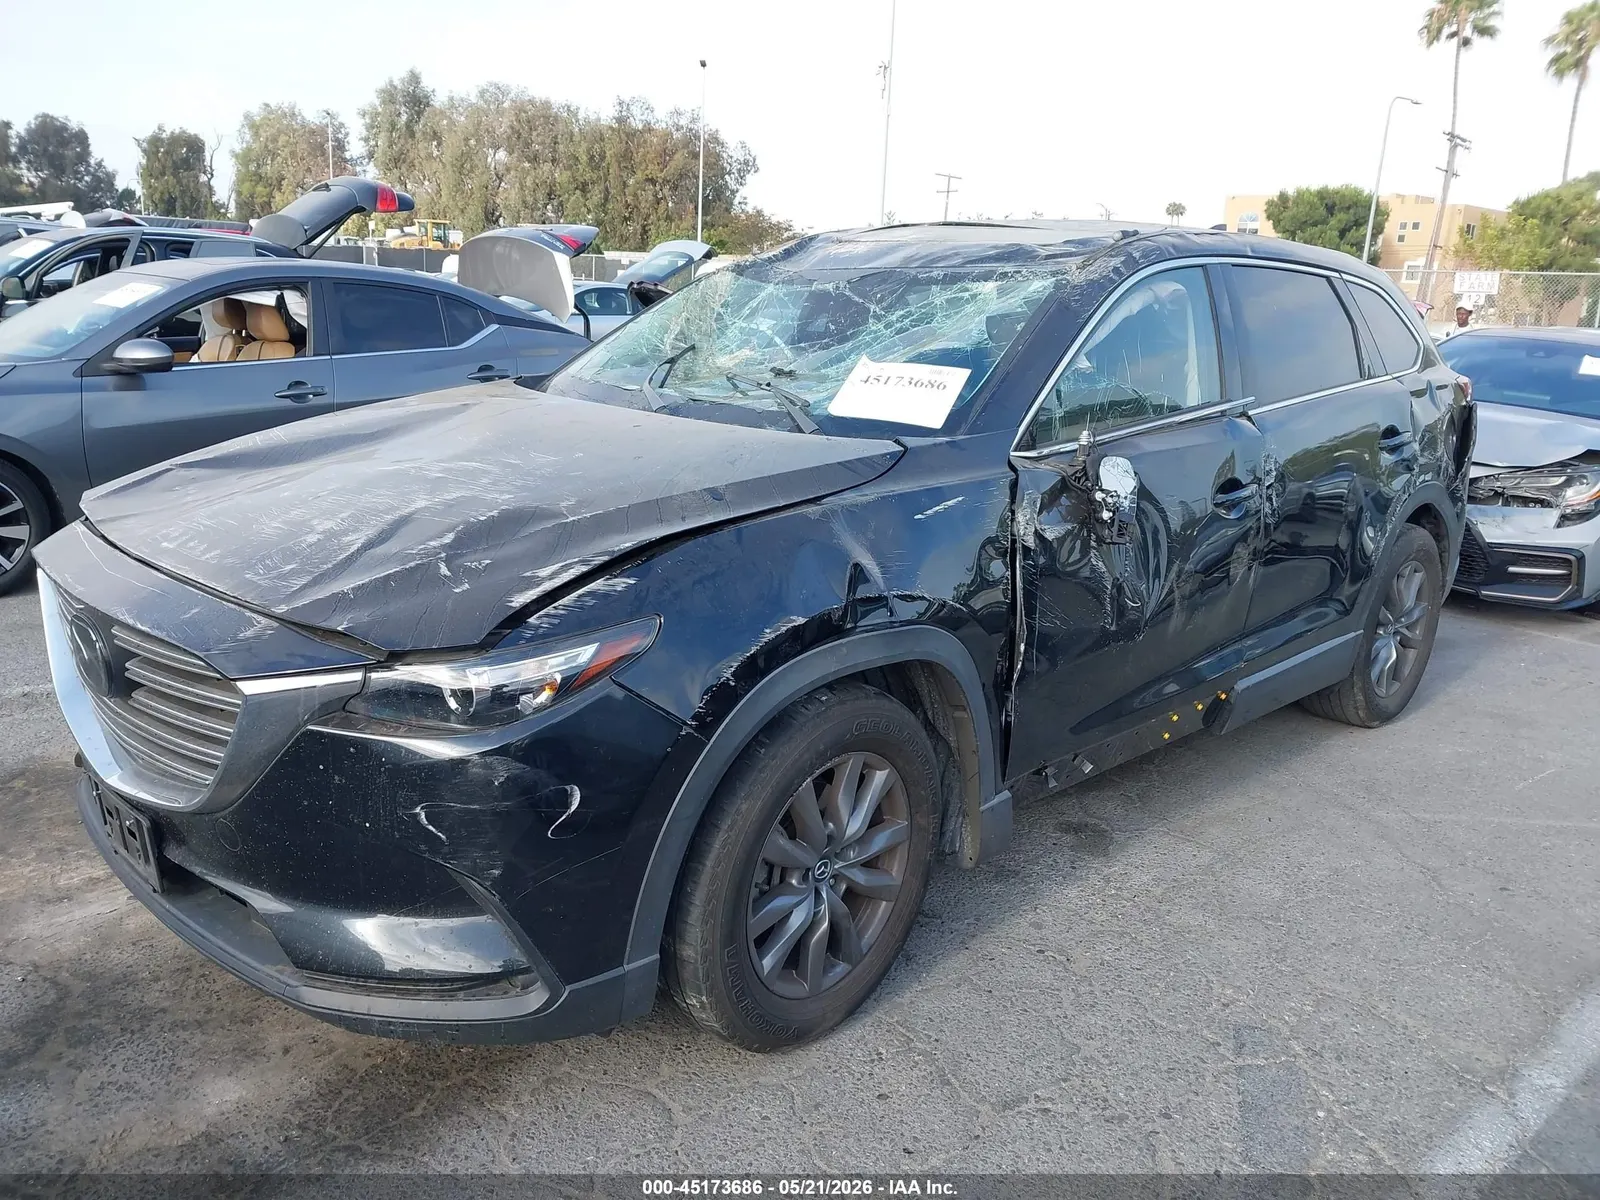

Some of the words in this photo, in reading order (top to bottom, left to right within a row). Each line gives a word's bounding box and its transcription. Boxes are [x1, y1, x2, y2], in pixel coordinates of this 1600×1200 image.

[1458, 273, 1497, 281] STATE
[1459, 281, 1496, 290] FARM
[1468, 294, 1481, 304] 12
[859, 375, 947, 391] 45173686
[724, 943, 799, 1039] YOKOHAMA
